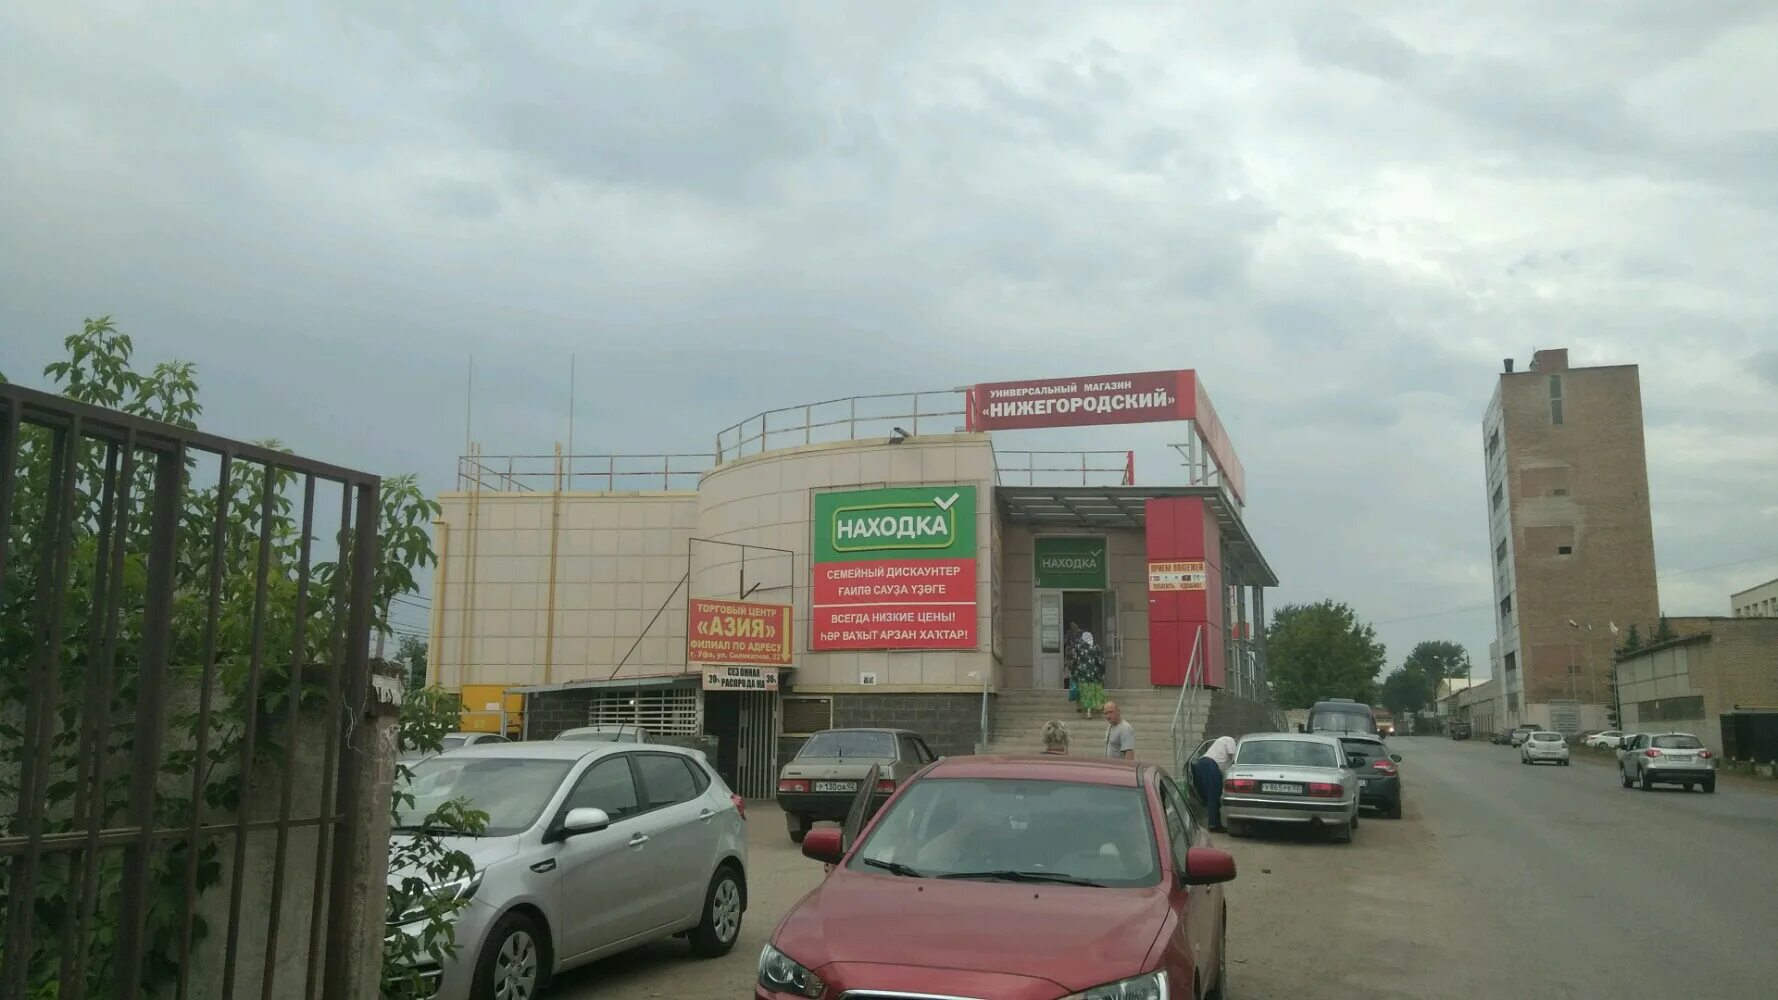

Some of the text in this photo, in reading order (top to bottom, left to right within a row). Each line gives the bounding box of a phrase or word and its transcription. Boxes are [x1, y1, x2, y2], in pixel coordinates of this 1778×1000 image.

[990, 380, 1132, 398] УНИВЕРСАЛЬНЫЙ МАГАЗИН
[982, 388, 1175, 417] «НИЖЕГОРОДСКИЙ»
[837, 516, 947, 539] НАХОДКА
[1042, 557, 1097, 569] НАХОДКА
[827, 566, 961, 580] СЕМЕЙНЫЙ ДИСКАУНТЕР
[697, 604, 777, 617] ТОРГОВЫЙ ЦЕНТР
[831, 612, 956, 625] ВСЕГДА НИЗКИЕ ЦЕНЫ!
[697, 616, 776, 638] «АЗИЯ»
[690, 640, 783, 652] ФИЛИАЛ ПО АДРЕСУ
